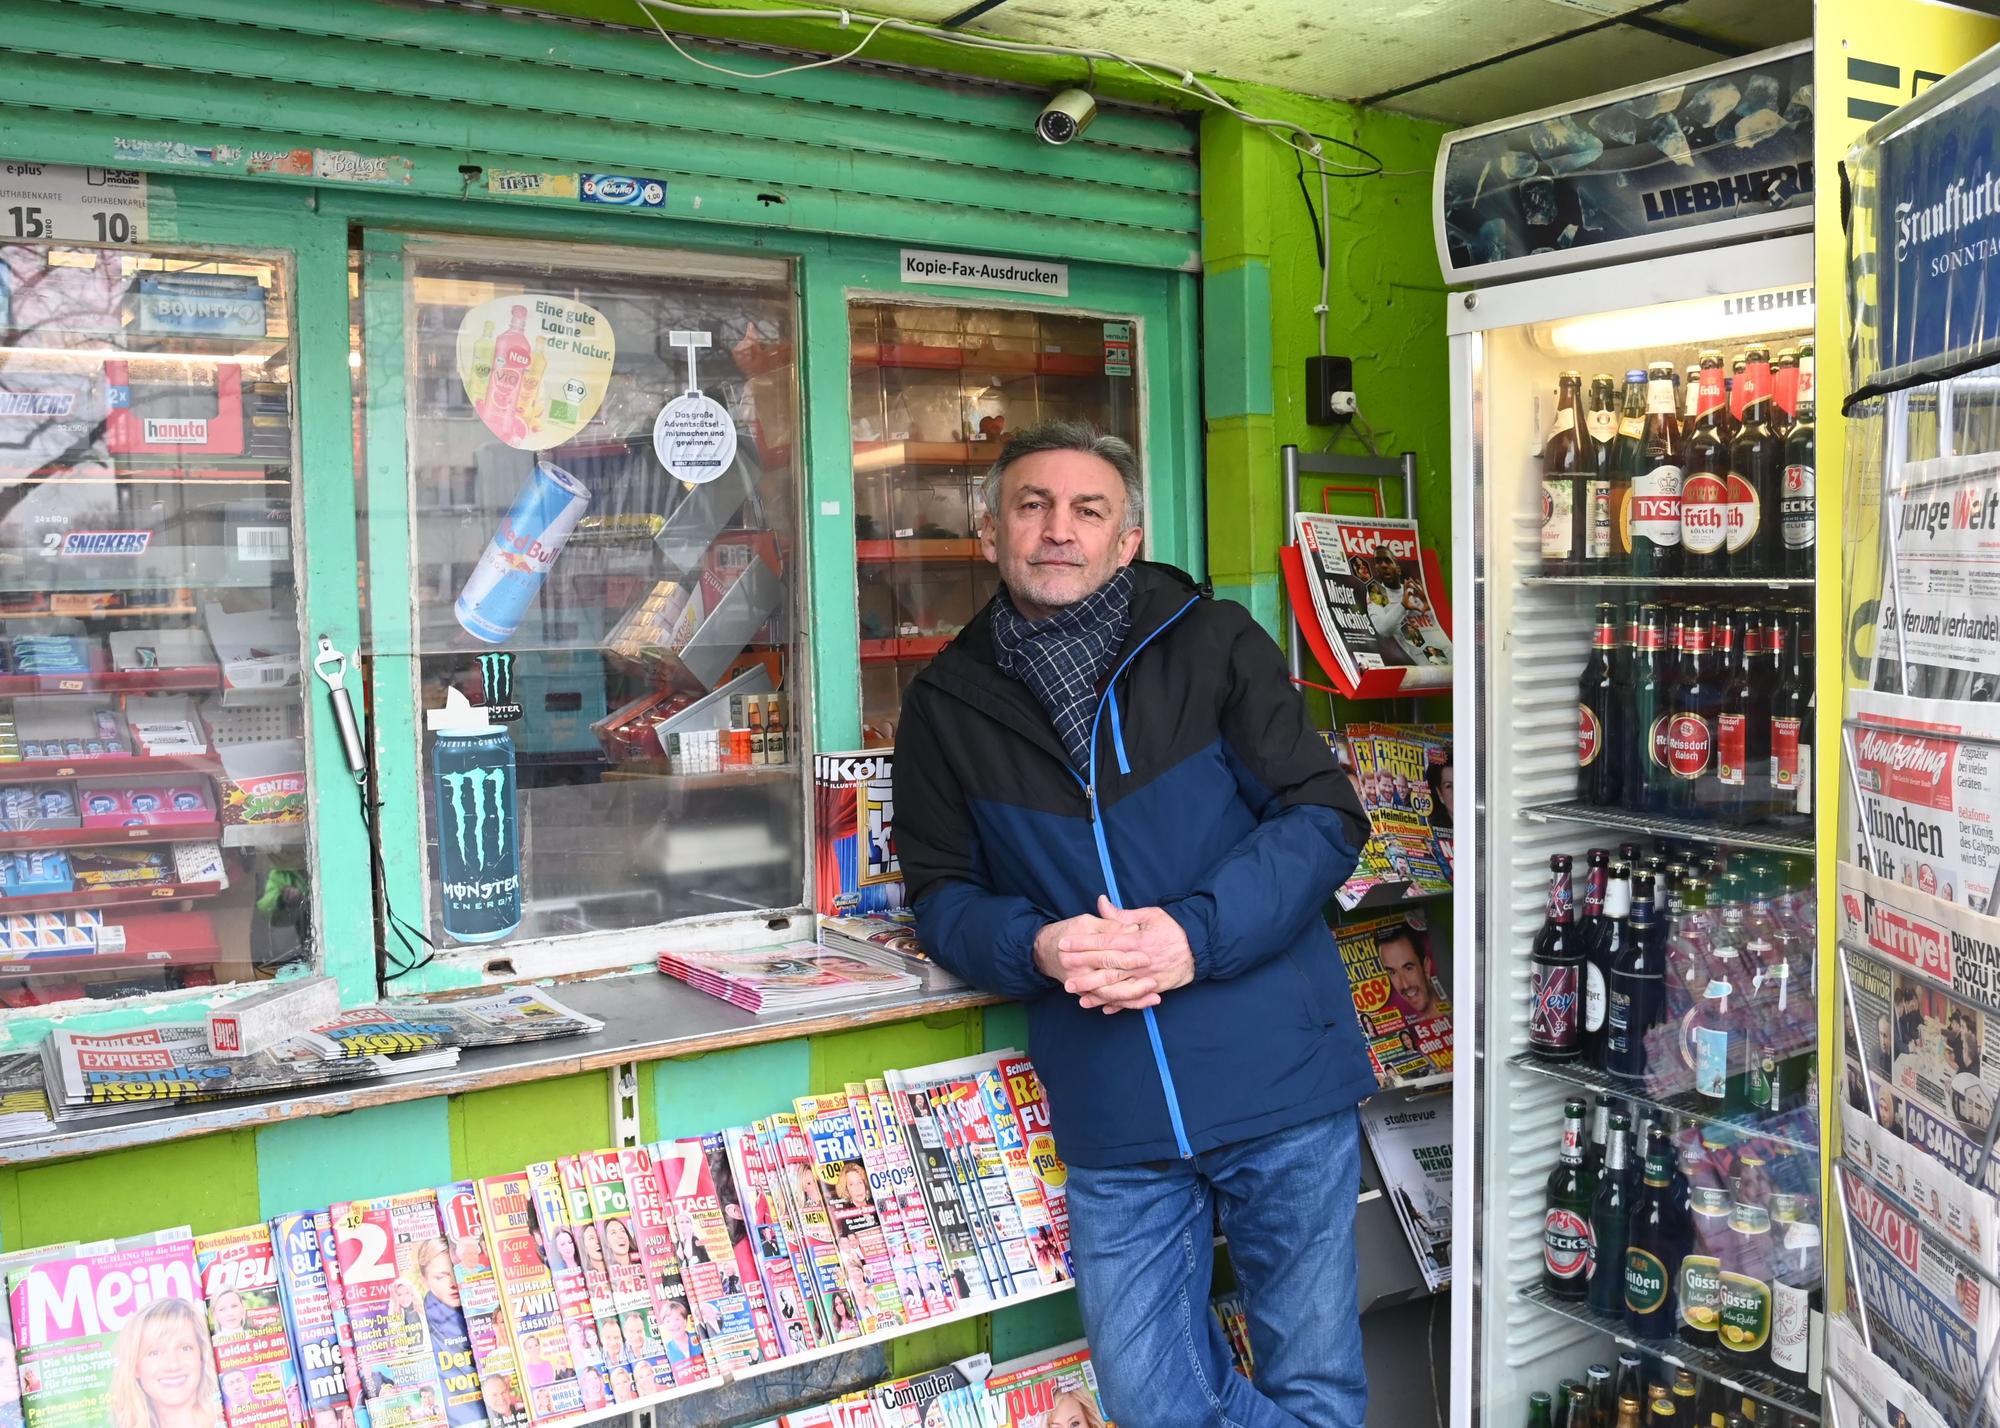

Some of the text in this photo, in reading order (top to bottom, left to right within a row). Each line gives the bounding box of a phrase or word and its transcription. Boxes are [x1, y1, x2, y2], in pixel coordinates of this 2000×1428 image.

[0, 190, 62, 200] UTHABENKARTE
[587, 181, 594, 192] 2
[81, 195, 146, 208] GUTHABENKARTE
[8, 206, 43, 237] 15
[92, 212, 129, 242] 10
[906, 257, 1059, 285] Kopie-Fax-Ausdrucken
[157, 302, 231, 319] BOUNTY
[536, 300, 596, 326] Eine gute
[541, 318, 582, 338] Laune
[509, 351, 529, 364] Neu
[547, 336, 611, 361] der Natur.
[110, 389, 126, 402] 2x
[692, 411, 713, 419] große
[148, 420, 205, 438] hanuta
[1684, 507, 1722, 528] früh
[1898, 486, 1998, 540] junge Welt
[40, 533, 148, 556] 2 SNICKERS
[526, 541, 559, 564] Bull
[1341, 528, 1415, 558] kicker
[1325, 579, 1356, 605] Mister
[1927, 582, 1933, 593] 5
[1331, 607, 1375, 635] Wichtig
[1920, 610, 1942, 636] und
[1375, 740, 1424, 765] FREIZEIT
[1668, 736, 1708, 751] Reissdorf
[1960, 745, 1989, 761] Engpässe
[1859, 730, 1948, 786] Abendzeitung
[1957, 760, 1988, 776] bei vielen
[1377, 758, 1425, 782] MONAT
[253, 779, 299, 793] CENTER
[1957, 775, 1982, 791] Geräten
[1380, 809, 1419, 825] Heimliche
[1958, 807, 1991, 823] Belafonte
[1960, 821, 1994, 842] Der König
[1961, 837, 2000, 857] des Calypso
[1961, 853, 1988, 868] wird 95
[443, 874, 518, 901] MONSTER
[453, 896, 512, 910] ENERGY
[1867, 901, 1949, 974] Hürriyet
[1955, 955, 1988, 990] GÖZÜ
[1415, 1016, 1453, 1039] Es gibt
[1419, 1040, 1444, 1054] eine
[82, 1051, 168, 1068] EXPRESS
[1384, 1109, 1436, 1127] stadtrevue
[1035, 1140, 1051, 1150] NUR
[1907, 1106, 1963, 1168] 40 SAAT
[532, 1164, 549, 1177] 59
[622, 1150, 650, 1174] 20
[891, 1164, 916, 1187] 0,99
[504, 1183, 519, 1195] DAS
[671, 1195, 719, 1216] TAGE
[805, 1213, 825, 1224] MEIN
[1843, 1167, 1918, 1268] SÖZCÜ
[503, 1240, 529, 1253] Kate
[646, 1235, 668, 1247] ANDY
[336, 1221, 396, 1285] 2
[504, 1264, 544, 1279] William
[28, 1260, 202, 1336] Mein
[345, 1287, 368, 1299] die
[507, 1280, 553, 1295] HURRA!
[655, 1283, 686, 1301] Neue
[1719, 1284, 1762, 1311] Gösser
[218, 1337, 286, 1359] Leidet sie am
[437, 1349, 472, 1372] Der
[445, 1371, 480, 1392] von
[882, 1373, 954, 1410] Computer
[28, 1397, 98, 1419] Partnersuche
[1008, 1378, 1058, 1421] pur
